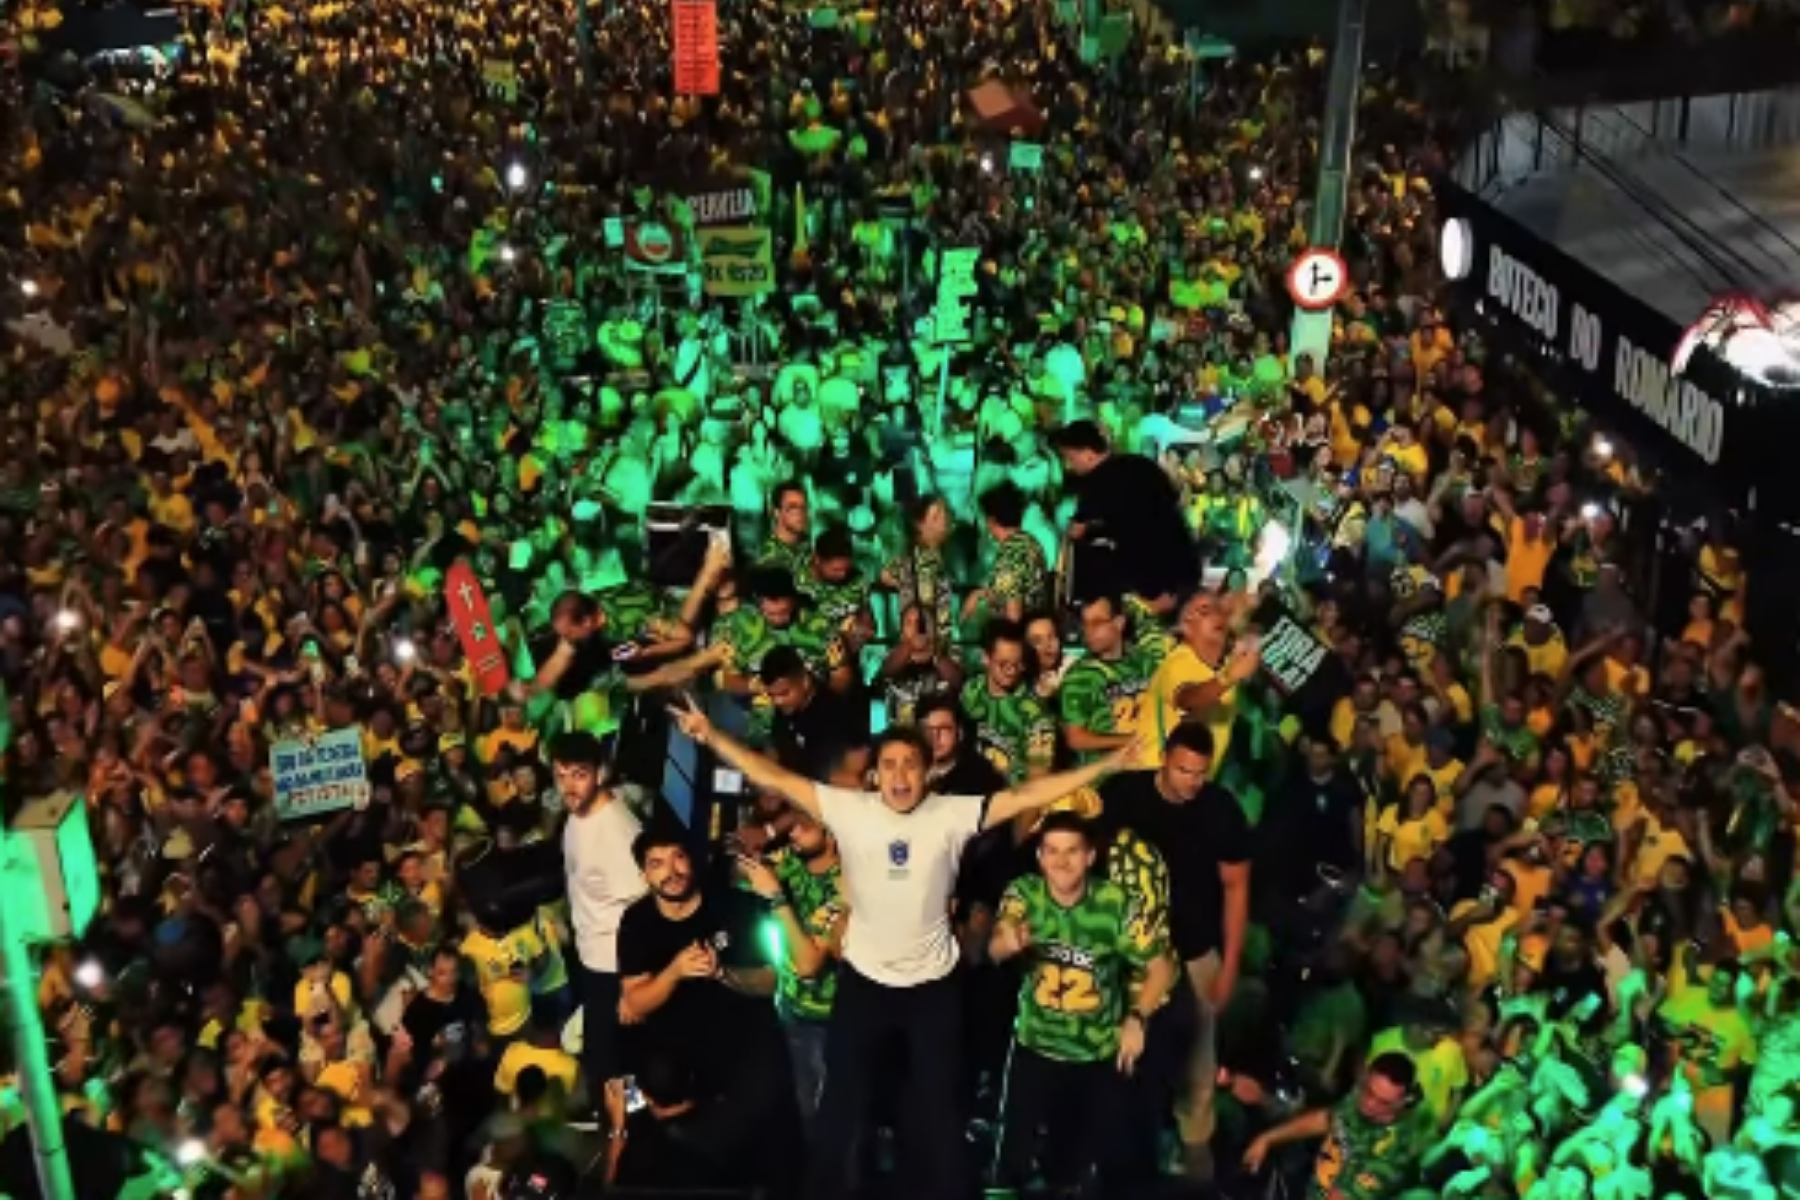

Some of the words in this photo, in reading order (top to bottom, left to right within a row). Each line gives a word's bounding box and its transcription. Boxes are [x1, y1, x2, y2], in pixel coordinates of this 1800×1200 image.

[1489, 243, 1558, 340] BOTECO
[1569, 302, 1602, 373] DO
[1036, 962, 1101, 1013] 22
